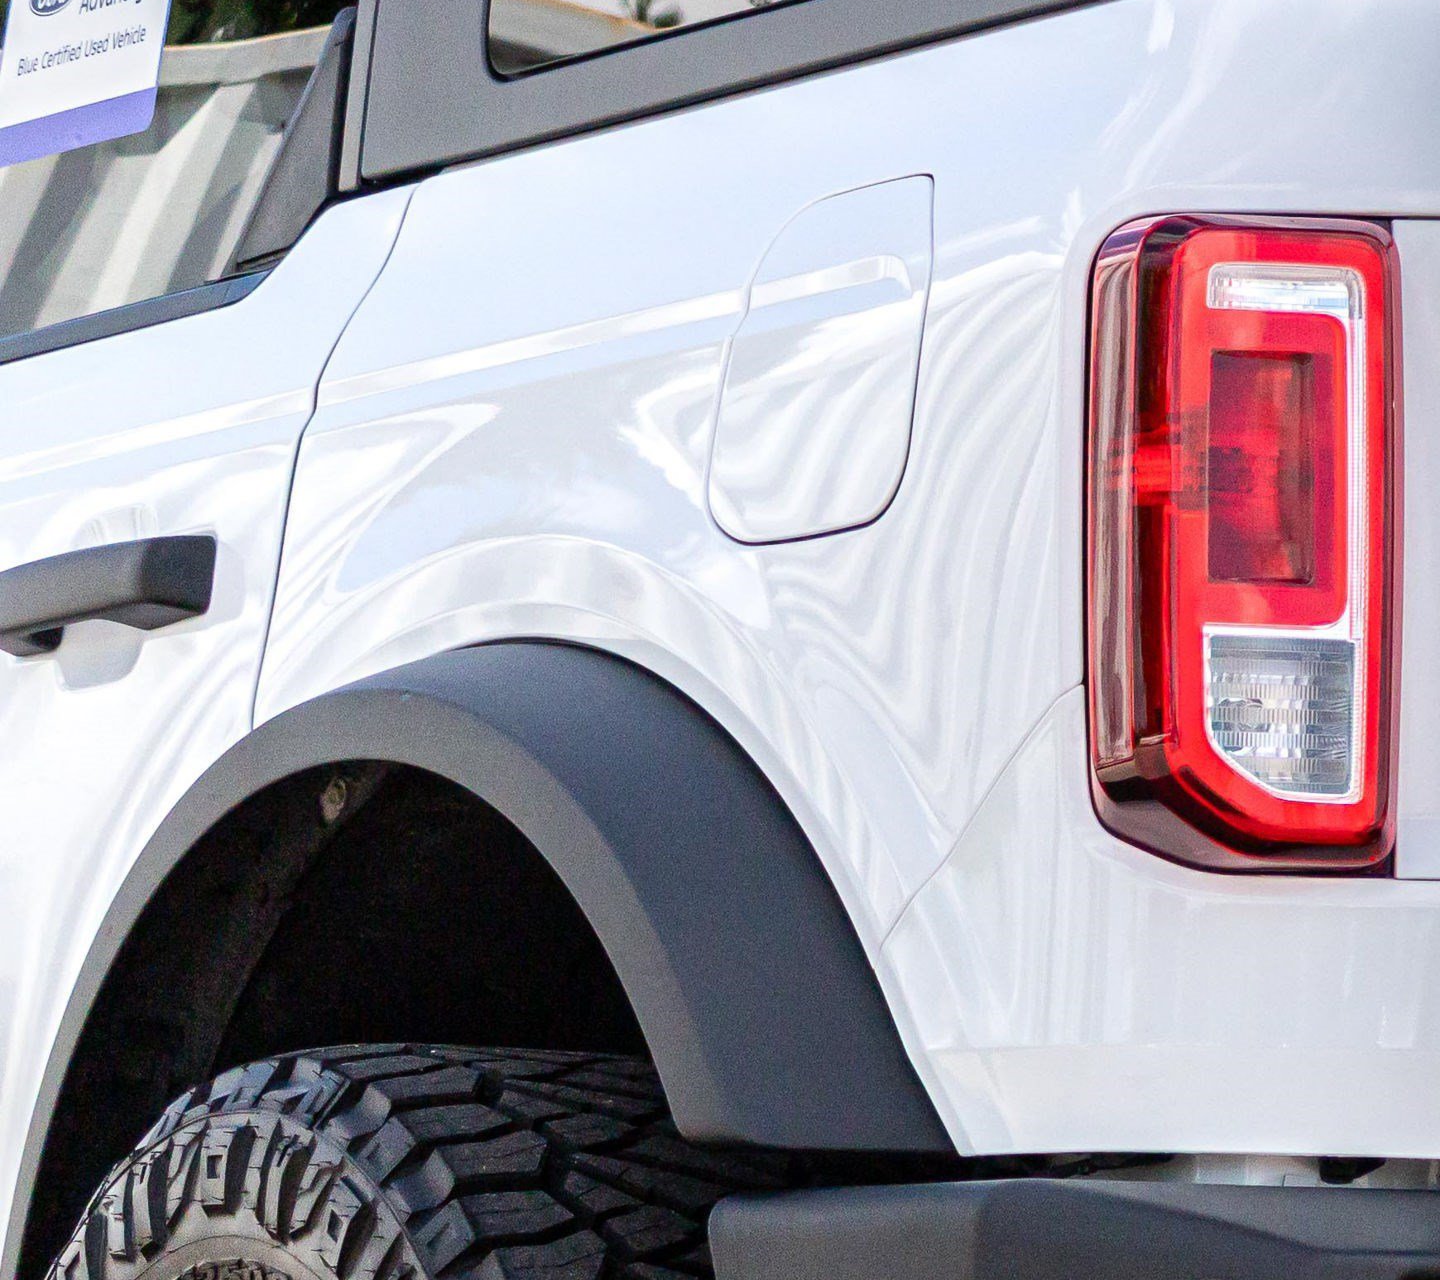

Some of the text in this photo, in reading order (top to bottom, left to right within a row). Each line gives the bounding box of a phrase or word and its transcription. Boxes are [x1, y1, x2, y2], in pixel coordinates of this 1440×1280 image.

[17, 24, 147, 77] Blue Certified Used Vehicle
